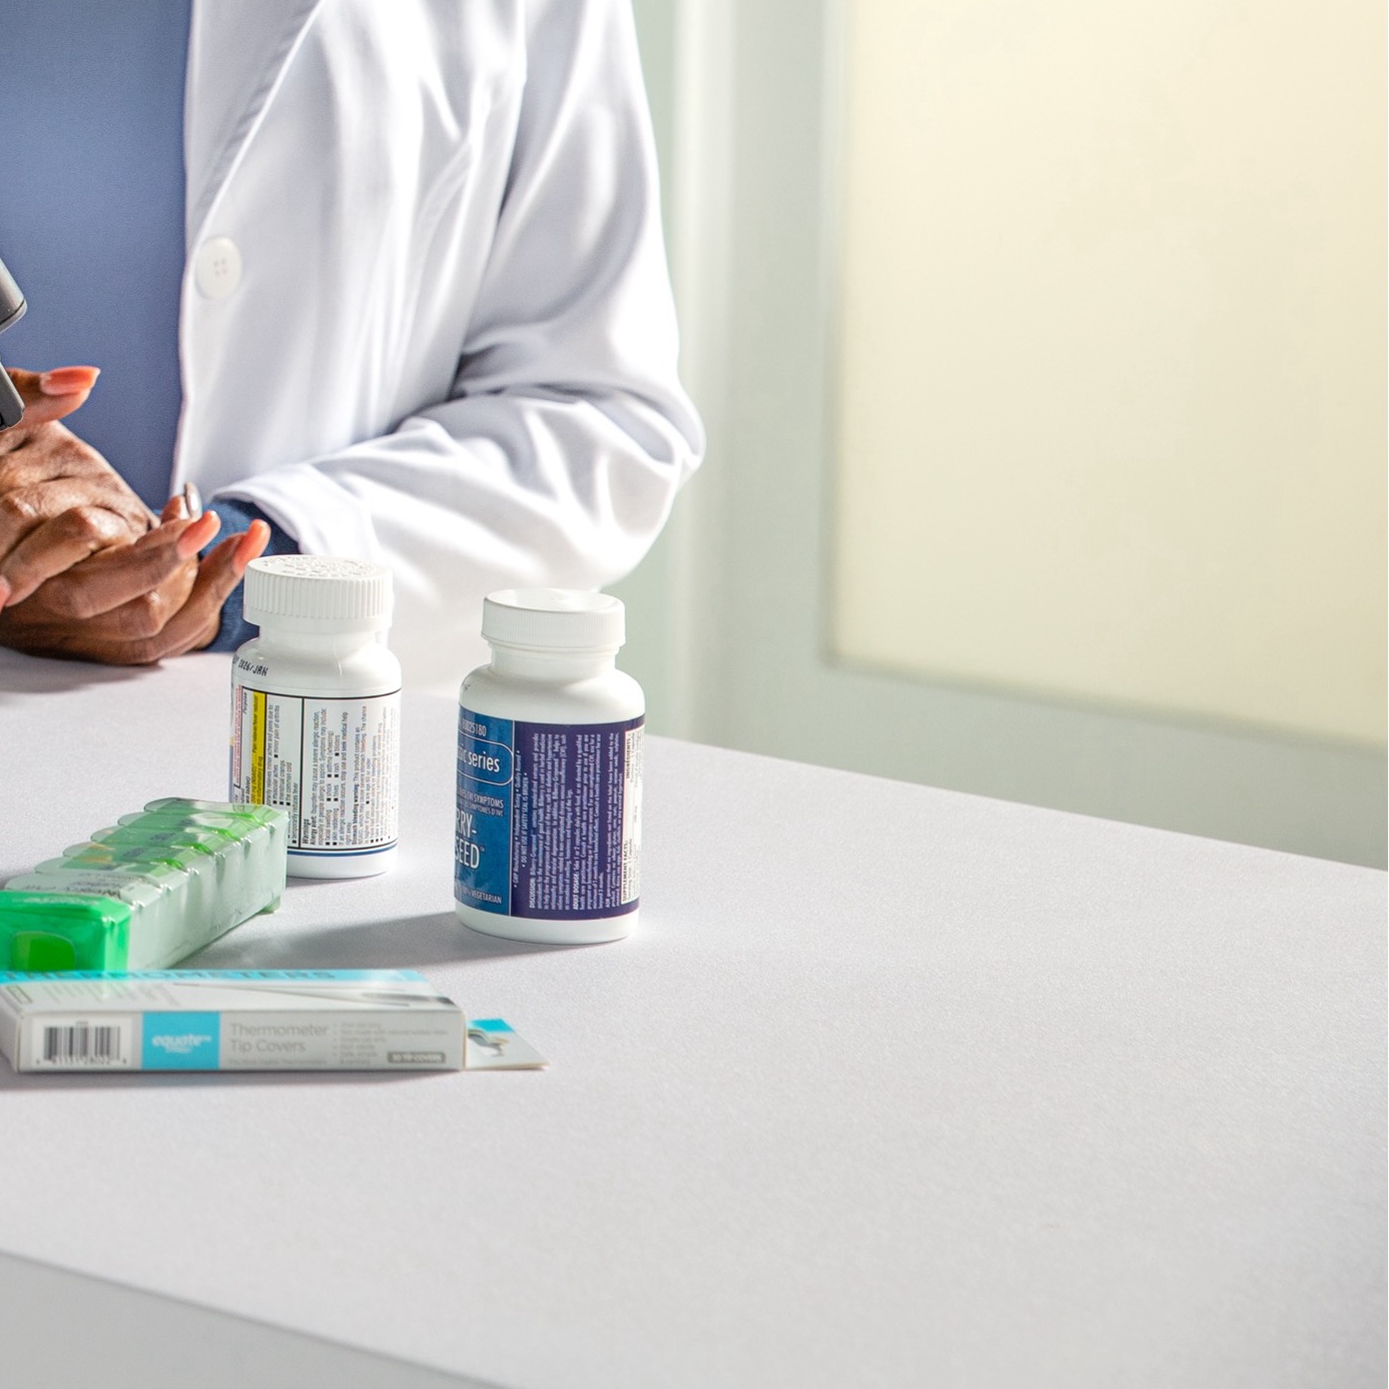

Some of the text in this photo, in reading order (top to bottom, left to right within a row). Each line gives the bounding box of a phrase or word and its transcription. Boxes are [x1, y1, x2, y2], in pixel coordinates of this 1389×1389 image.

[468, 750, 500, 773] series
[474, 794, 504, 809] SYMPTOMS
[301, 818, 309, 844] Warnings
[471, 889, 502, 904] VEGETARIAN
[230, 1022, 328, 1037] Thermometer
[152, 1034, 203, 1049] equate
[230, 1038, 306, 1054] Tip Covers
